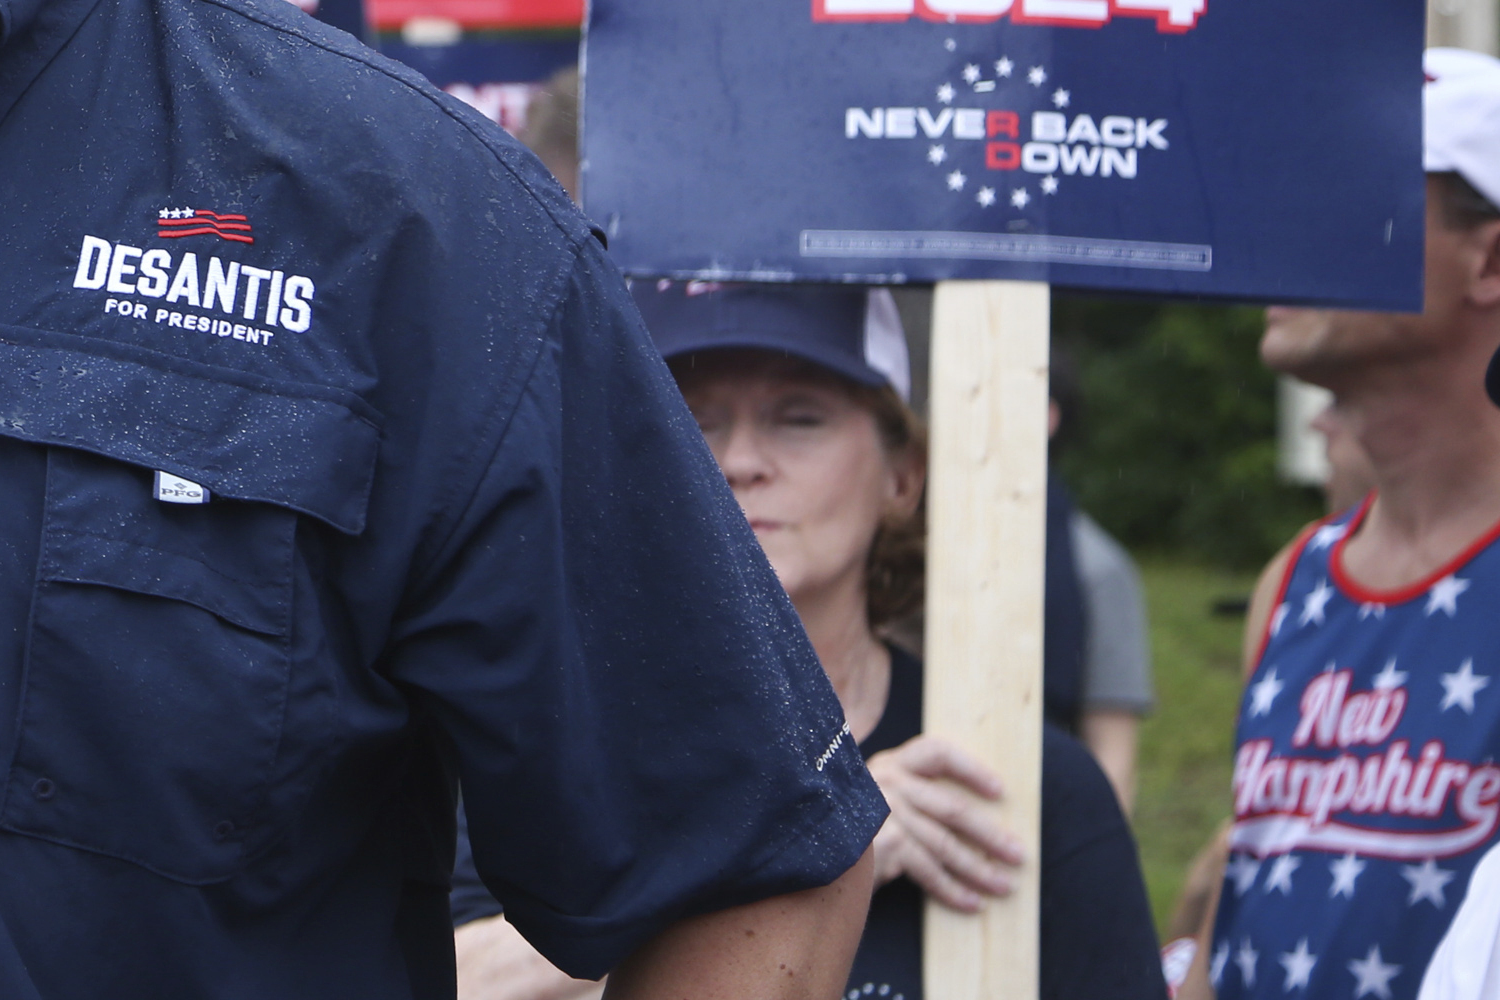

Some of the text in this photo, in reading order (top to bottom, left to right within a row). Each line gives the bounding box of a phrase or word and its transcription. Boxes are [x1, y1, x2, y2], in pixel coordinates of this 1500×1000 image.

[845, 106, 1170, 150] NEVER BACK
[984, 141, 1139, 179] DOWN
[72, 234, 316, 334] DESANTIS
[104, 298, 275, 347] FOR PRESIDENT
[161, 487, 201, 498] PFG
[1292, 668, 1407, 748] New
